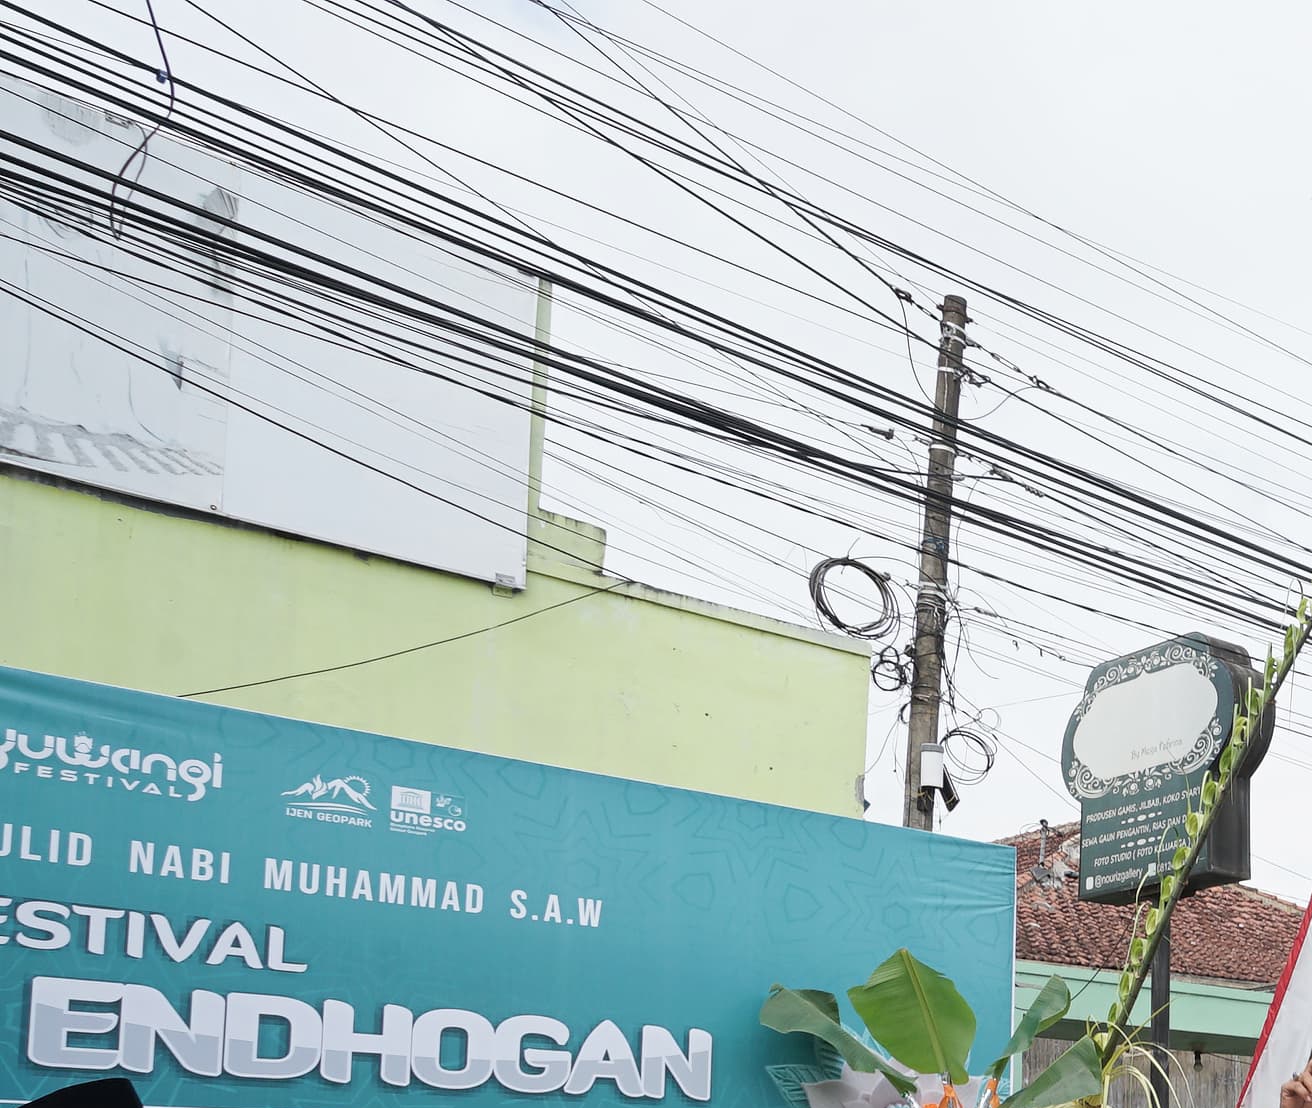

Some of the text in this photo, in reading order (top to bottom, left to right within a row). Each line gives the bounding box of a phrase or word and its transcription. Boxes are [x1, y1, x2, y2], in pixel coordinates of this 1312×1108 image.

[14, 761, 183, 798] FESTIVAL
[285, 807, 313, 820] IJEN
[316, 812, 373, 829] GEOPARK
[389, 810, 466, 833] unesco
[1086, 807, 1117, 824] PRODUSEN
[1162, 793, 1181, 808] KOKO
[1081, 836, 1098, 849] SEWA
[1099, 832, 1117, 845] GAUN
[1152, 819, 1167, 831] RIAS
[1094, 855, 1111, 868] FOTO
[1110, 850, 1132, 865] STUDIO
[1136, 845, 1154, 859] FOTO
[129, 840, 231, 885] NABI
[263, 857, 484, 914] MUHAMMAD
[509, 888, 603, 928] S.A.W
[0, 897, 309, 974] STIVAL
[27, 976, 713, 1102] ENDHOGAN
